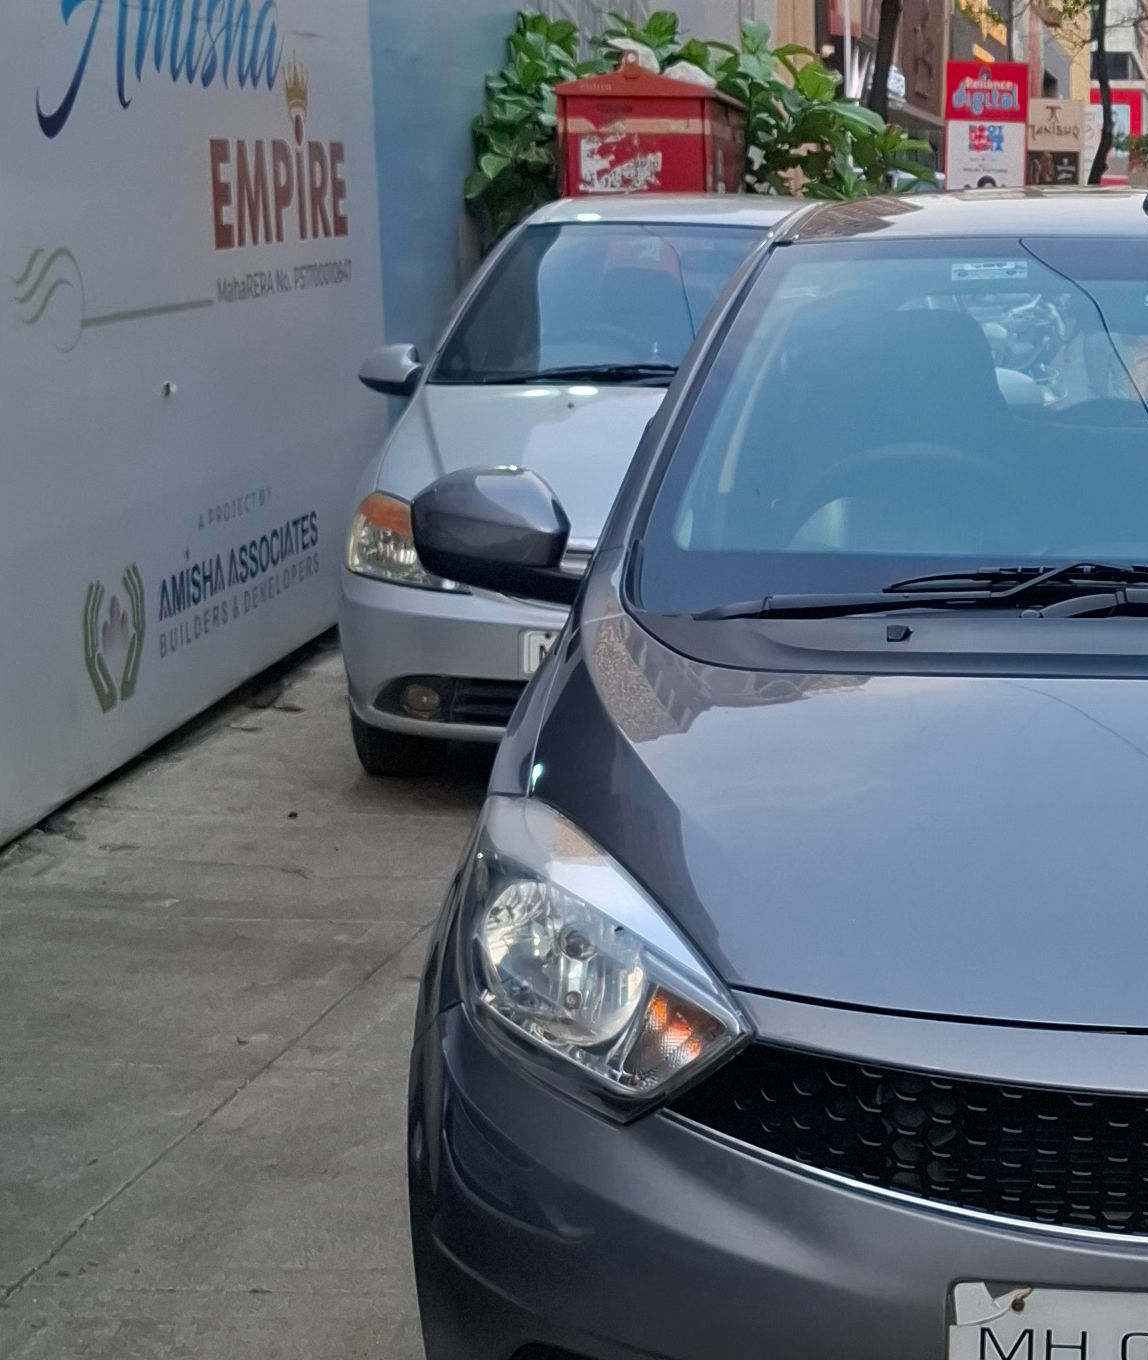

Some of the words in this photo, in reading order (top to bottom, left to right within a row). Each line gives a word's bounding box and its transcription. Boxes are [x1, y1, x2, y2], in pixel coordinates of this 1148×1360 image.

[952, 82, 1020, 115] digital
[965, 76, 1014, 90] Reliance
[209, 115, 348, 250] EMPIRE
[216, 270, 274, 303] MahaRERA
[198, 514, 205, 529] A
[208, 490, 257, 525] PROJECT
[159, 548, 226, 622] AMISHA
[228, 510, 319, 587] ASSOCIATES
[159, 601, 229, 659] BUILDERS
[232, 595, 240, 619] &
[243, 552, 320, 615] DEVELOPERS
